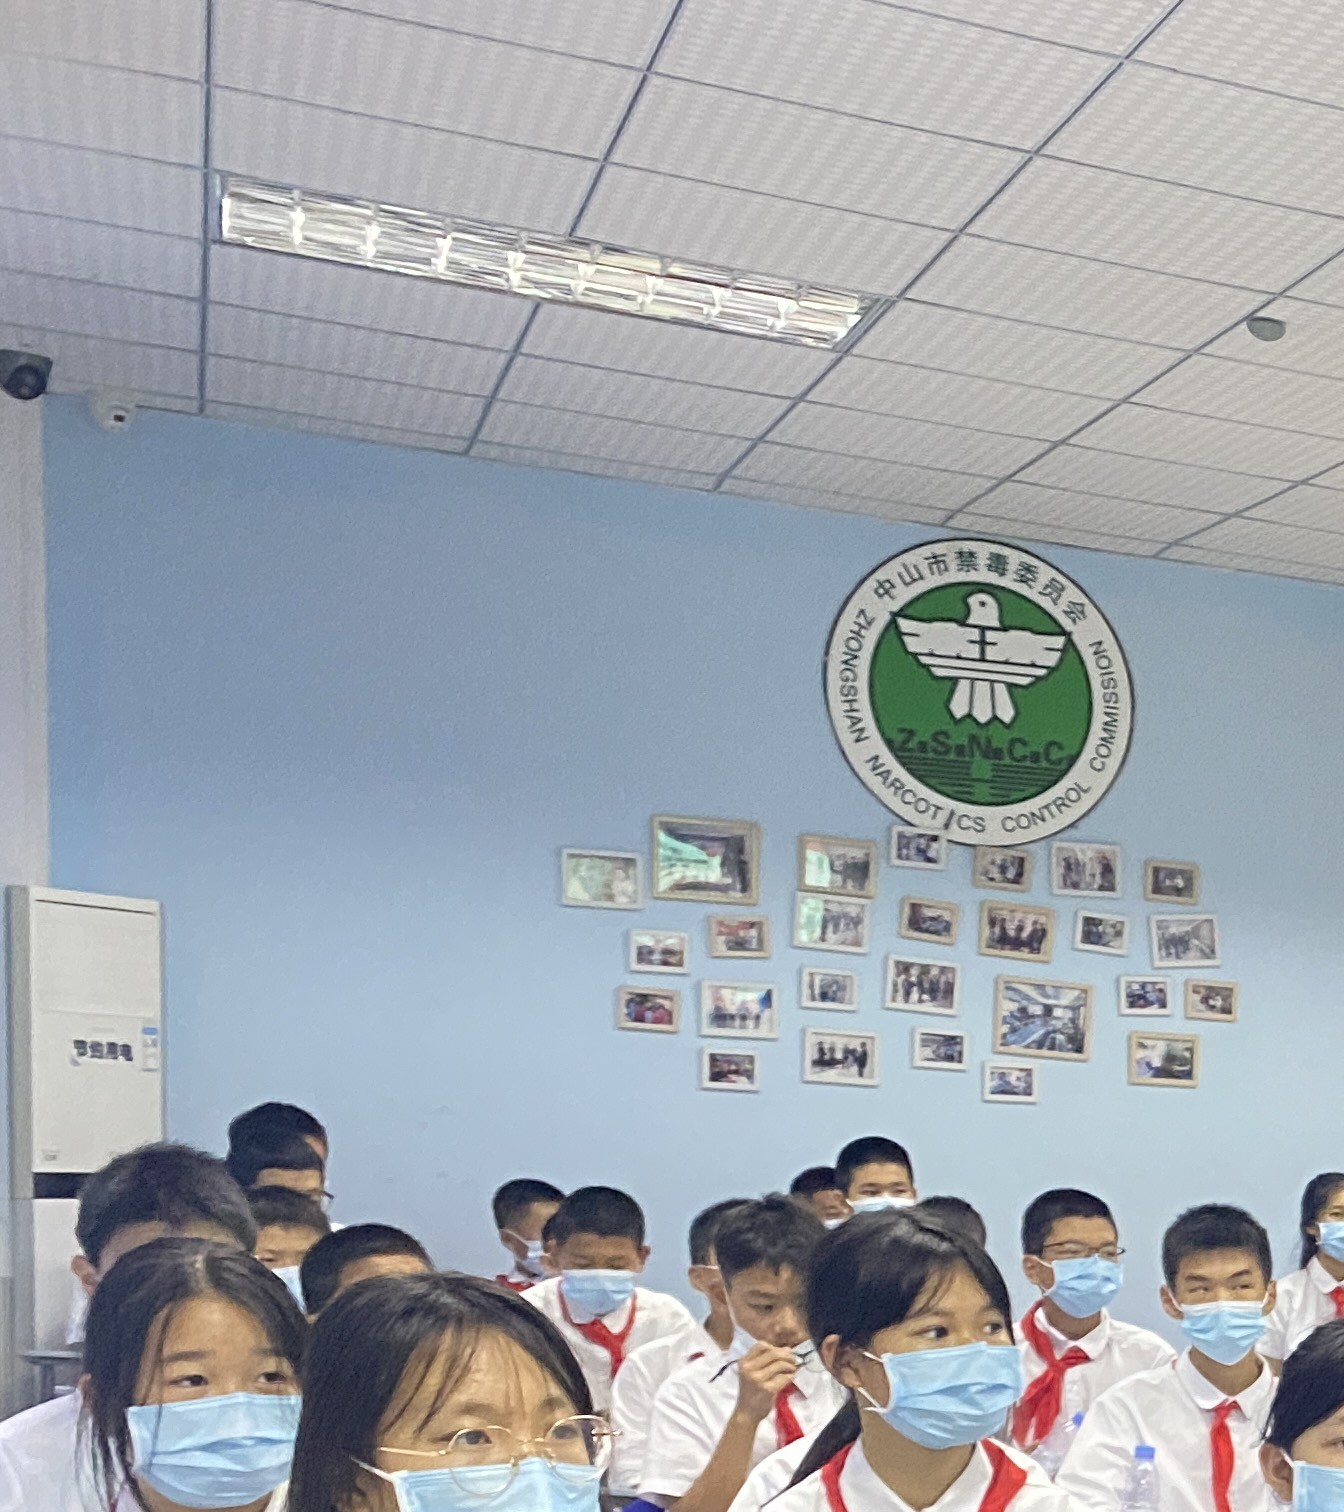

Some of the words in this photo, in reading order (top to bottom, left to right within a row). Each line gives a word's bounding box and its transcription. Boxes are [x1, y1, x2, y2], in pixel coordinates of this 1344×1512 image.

[873, 548, 1088, 625] 中山市禁毒委员会
[838, 607, 877, 744] ZHONGSHAN
[864, 753, 986, 833] NARCOTICS
[1000, 780, 1092, 833] CONTROL
[1088, 639, 1121, 773] COMMISSION
